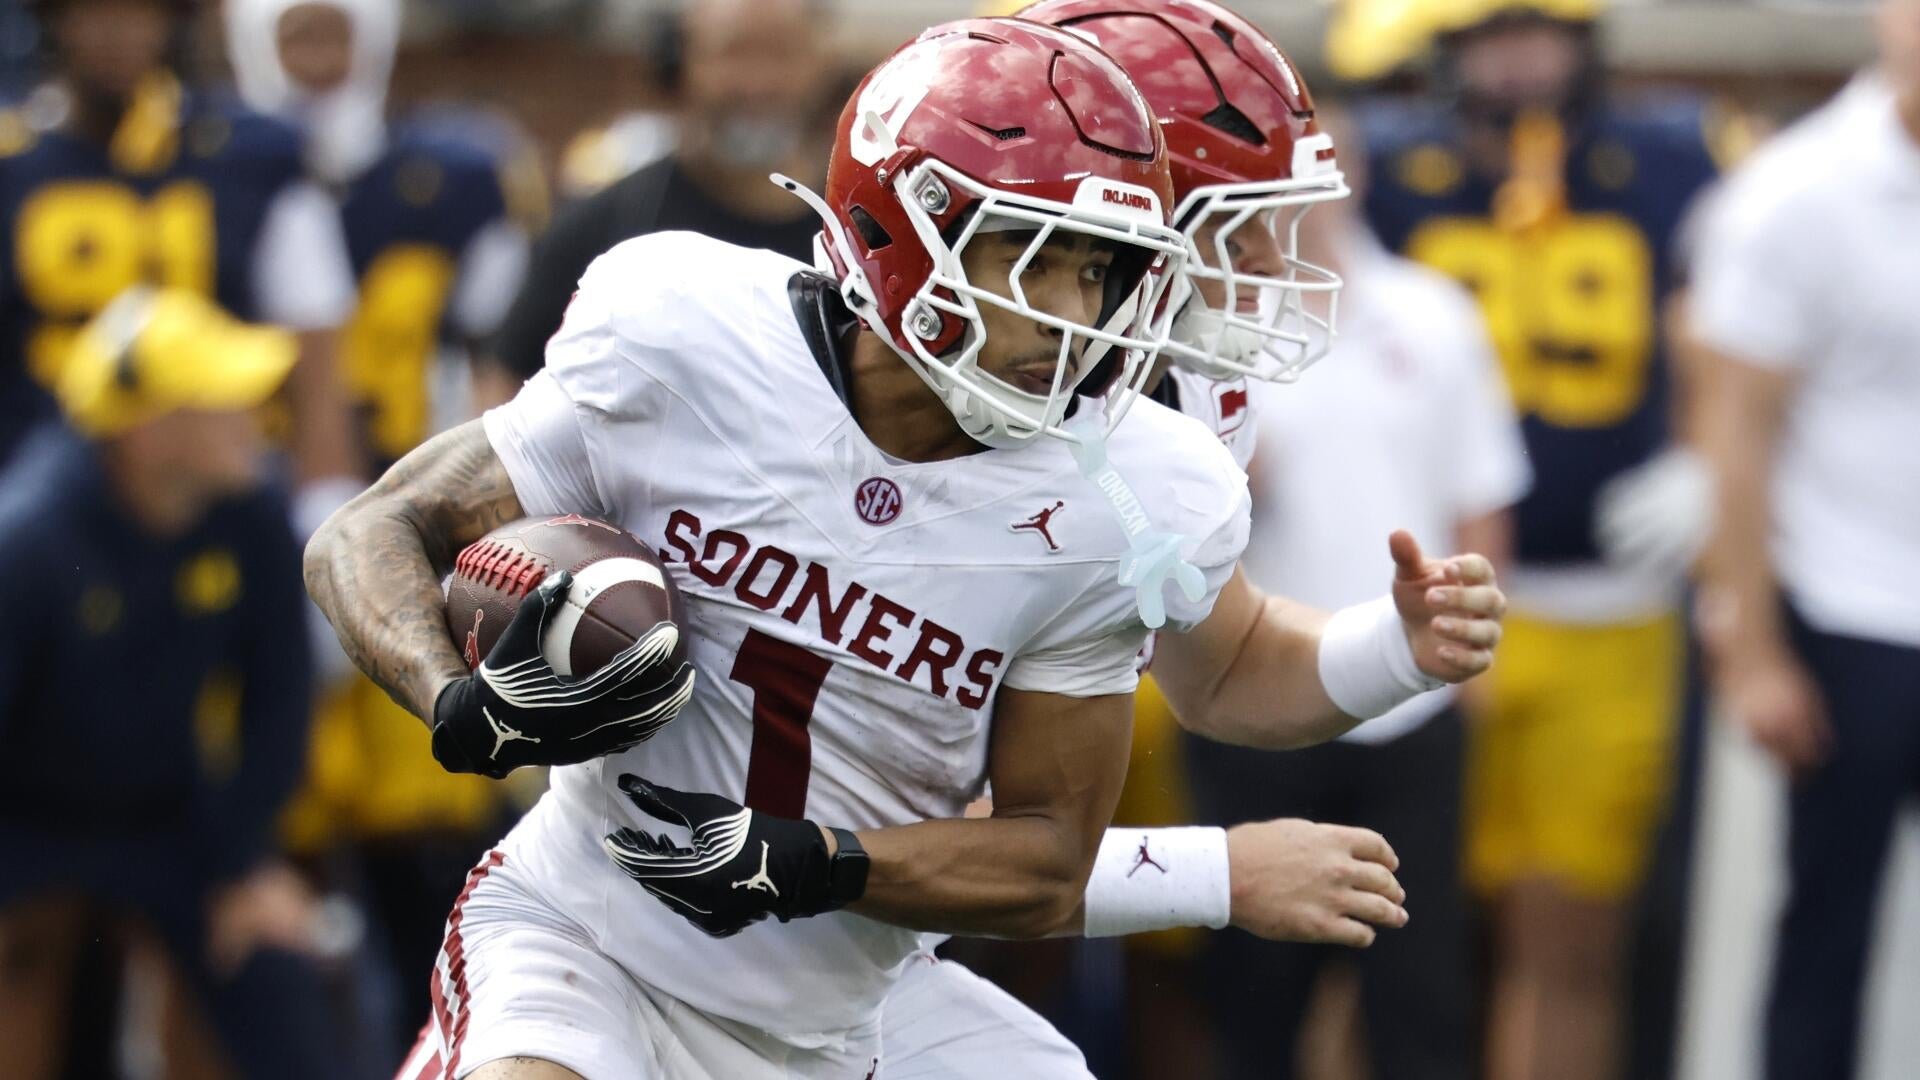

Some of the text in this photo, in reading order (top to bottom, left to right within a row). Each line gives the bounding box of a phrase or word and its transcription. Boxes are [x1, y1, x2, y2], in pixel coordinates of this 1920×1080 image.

[1102, 188, 1152, 211] OKLAHOMA
[858, 480, 899, 521] SEC
[1097, 470, 1150, 537] NXTRND
[659, 508, 1004, 711] SOONERS
[729, 626, 835, 821] 1
